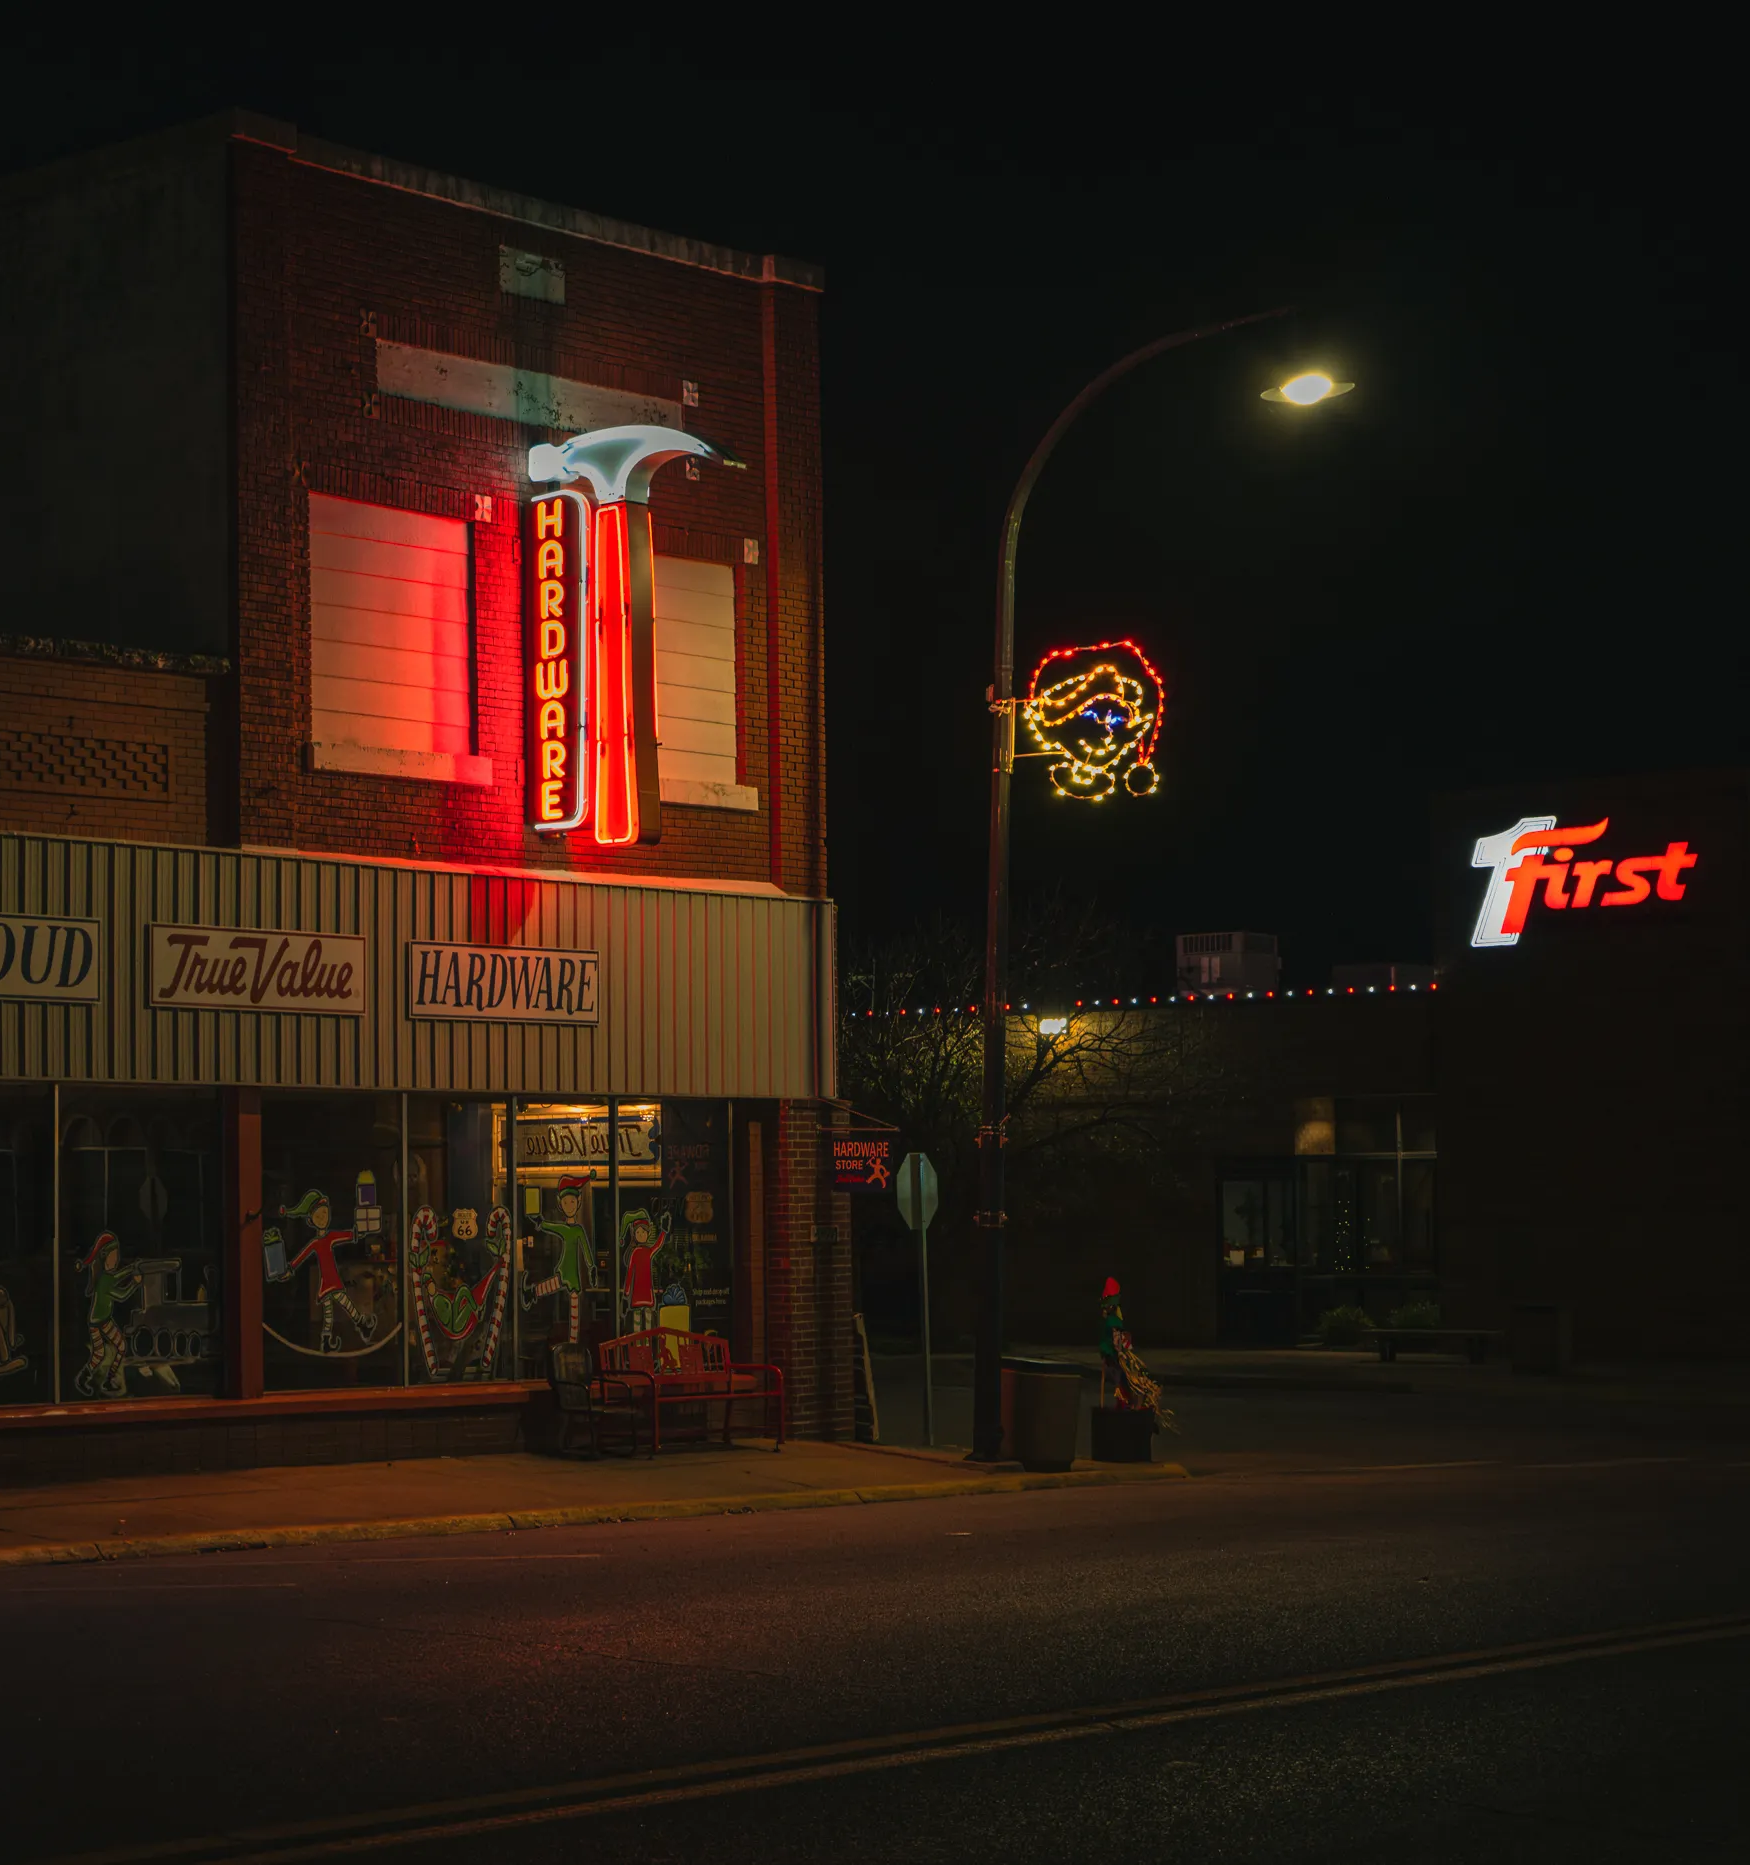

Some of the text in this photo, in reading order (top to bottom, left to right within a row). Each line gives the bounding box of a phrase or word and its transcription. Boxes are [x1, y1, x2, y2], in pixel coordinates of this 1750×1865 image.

[534, 498, 567, 820] HARDWARE
[416, 950, 598, 1013] HARDWARE
[833, 1141, 890, 1158] HARDWARE
[835, 1159, 864, 1170] STORE
[457, 1225, 473, 1236] 66
